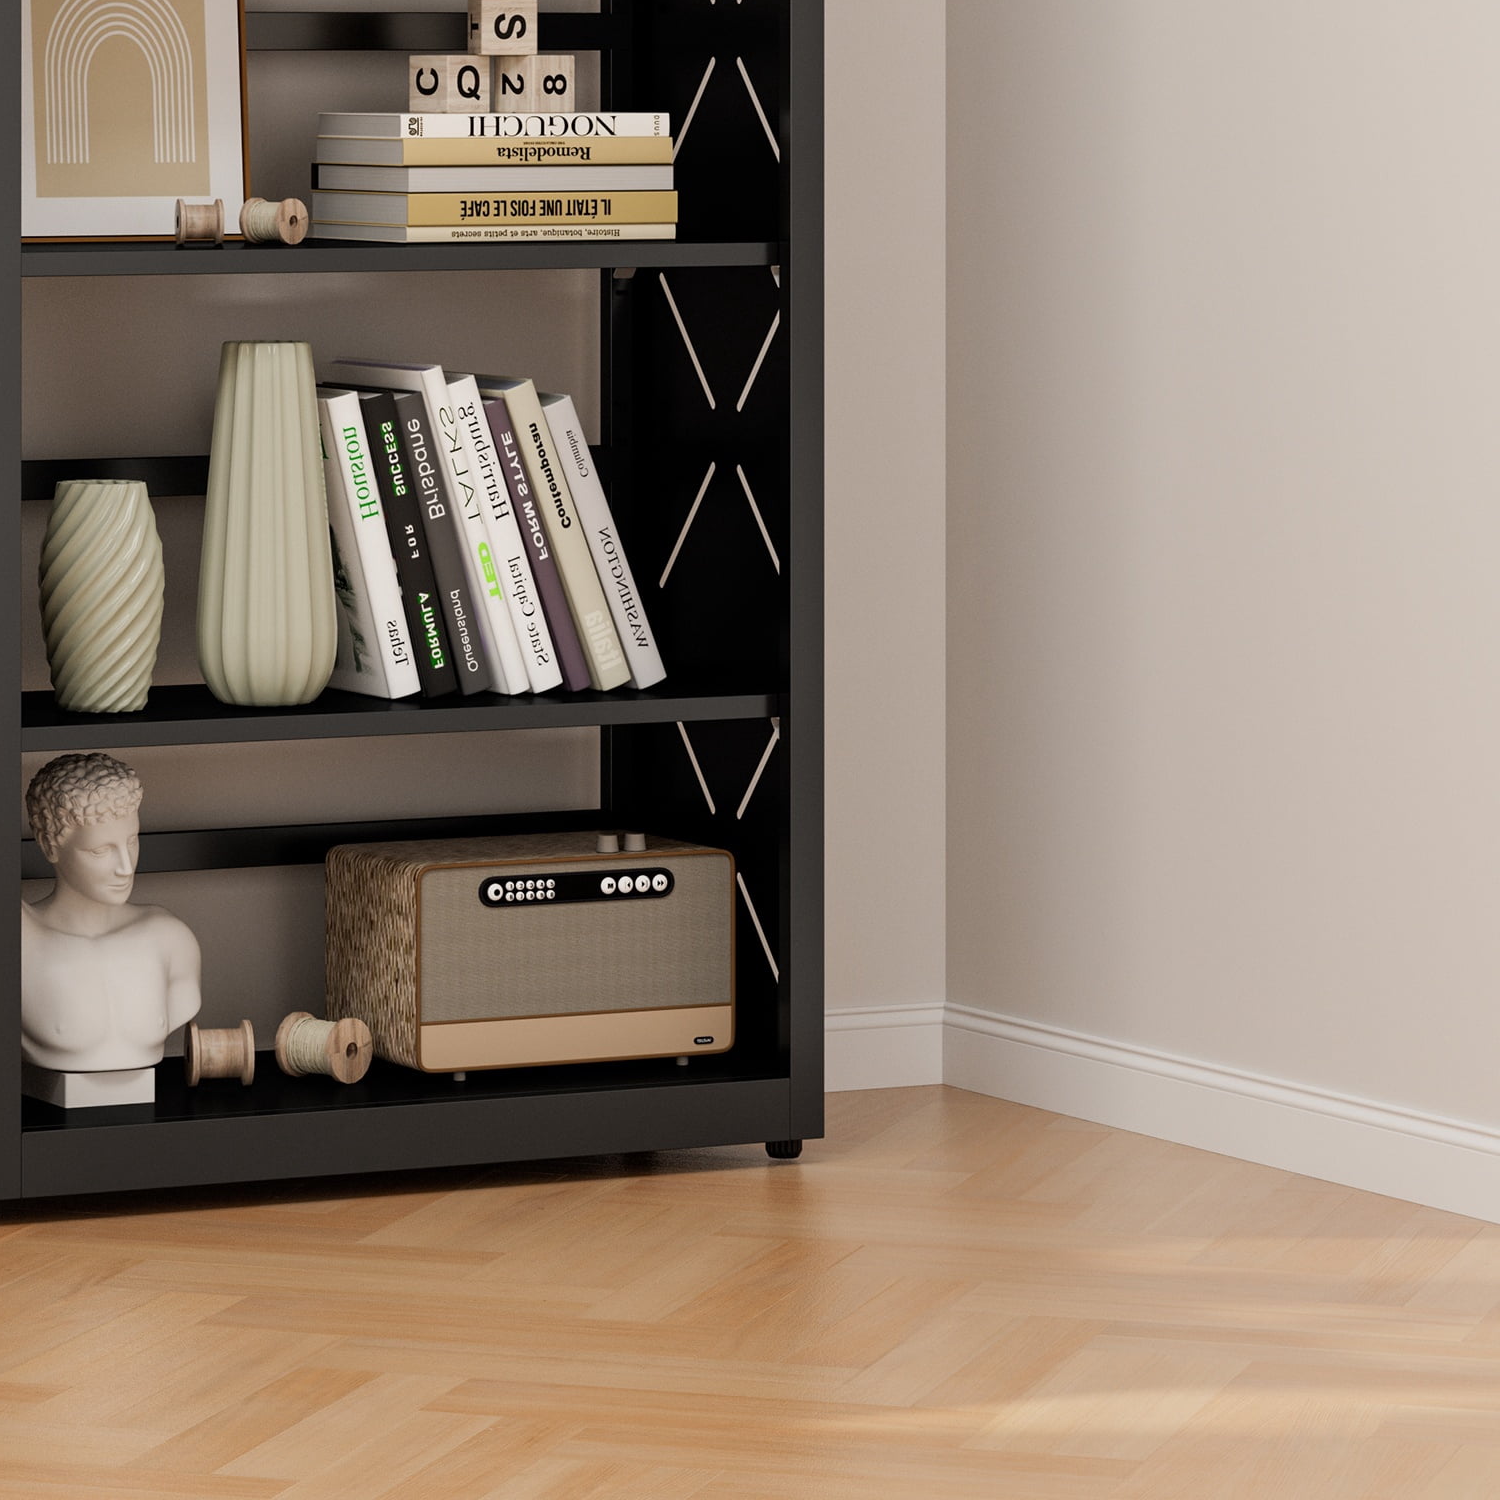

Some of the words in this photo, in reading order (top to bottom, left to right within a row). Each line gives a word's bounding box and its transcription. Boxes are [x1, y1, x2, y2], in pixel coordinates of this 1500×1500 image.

[494, 13, 527, 40] S
[415, 67, 439, 96] C
[457, 65, 481, 100] Q
[501, 73, 525, 95] 2
[543, 73, 567, 95] 8
[468, 114, 617, 137] NOGUCHI
[497, 146, 592, 162] Remodelista
[460, 199, 490, 221] CAFÉ
[493, 199, 507, 217] LE
[510, 199, 536, 217] FOIS
[539, 199, 563, 216] UNE
[565, 198, 598, 220] ÉTAIT
[600, 198, 611, 216] IL
[451, 229, 482, 238] secrets
[483, 228, 508, 238] petits
[510, 229, 519, 237] et
[520, 229, 538, 237] arts
